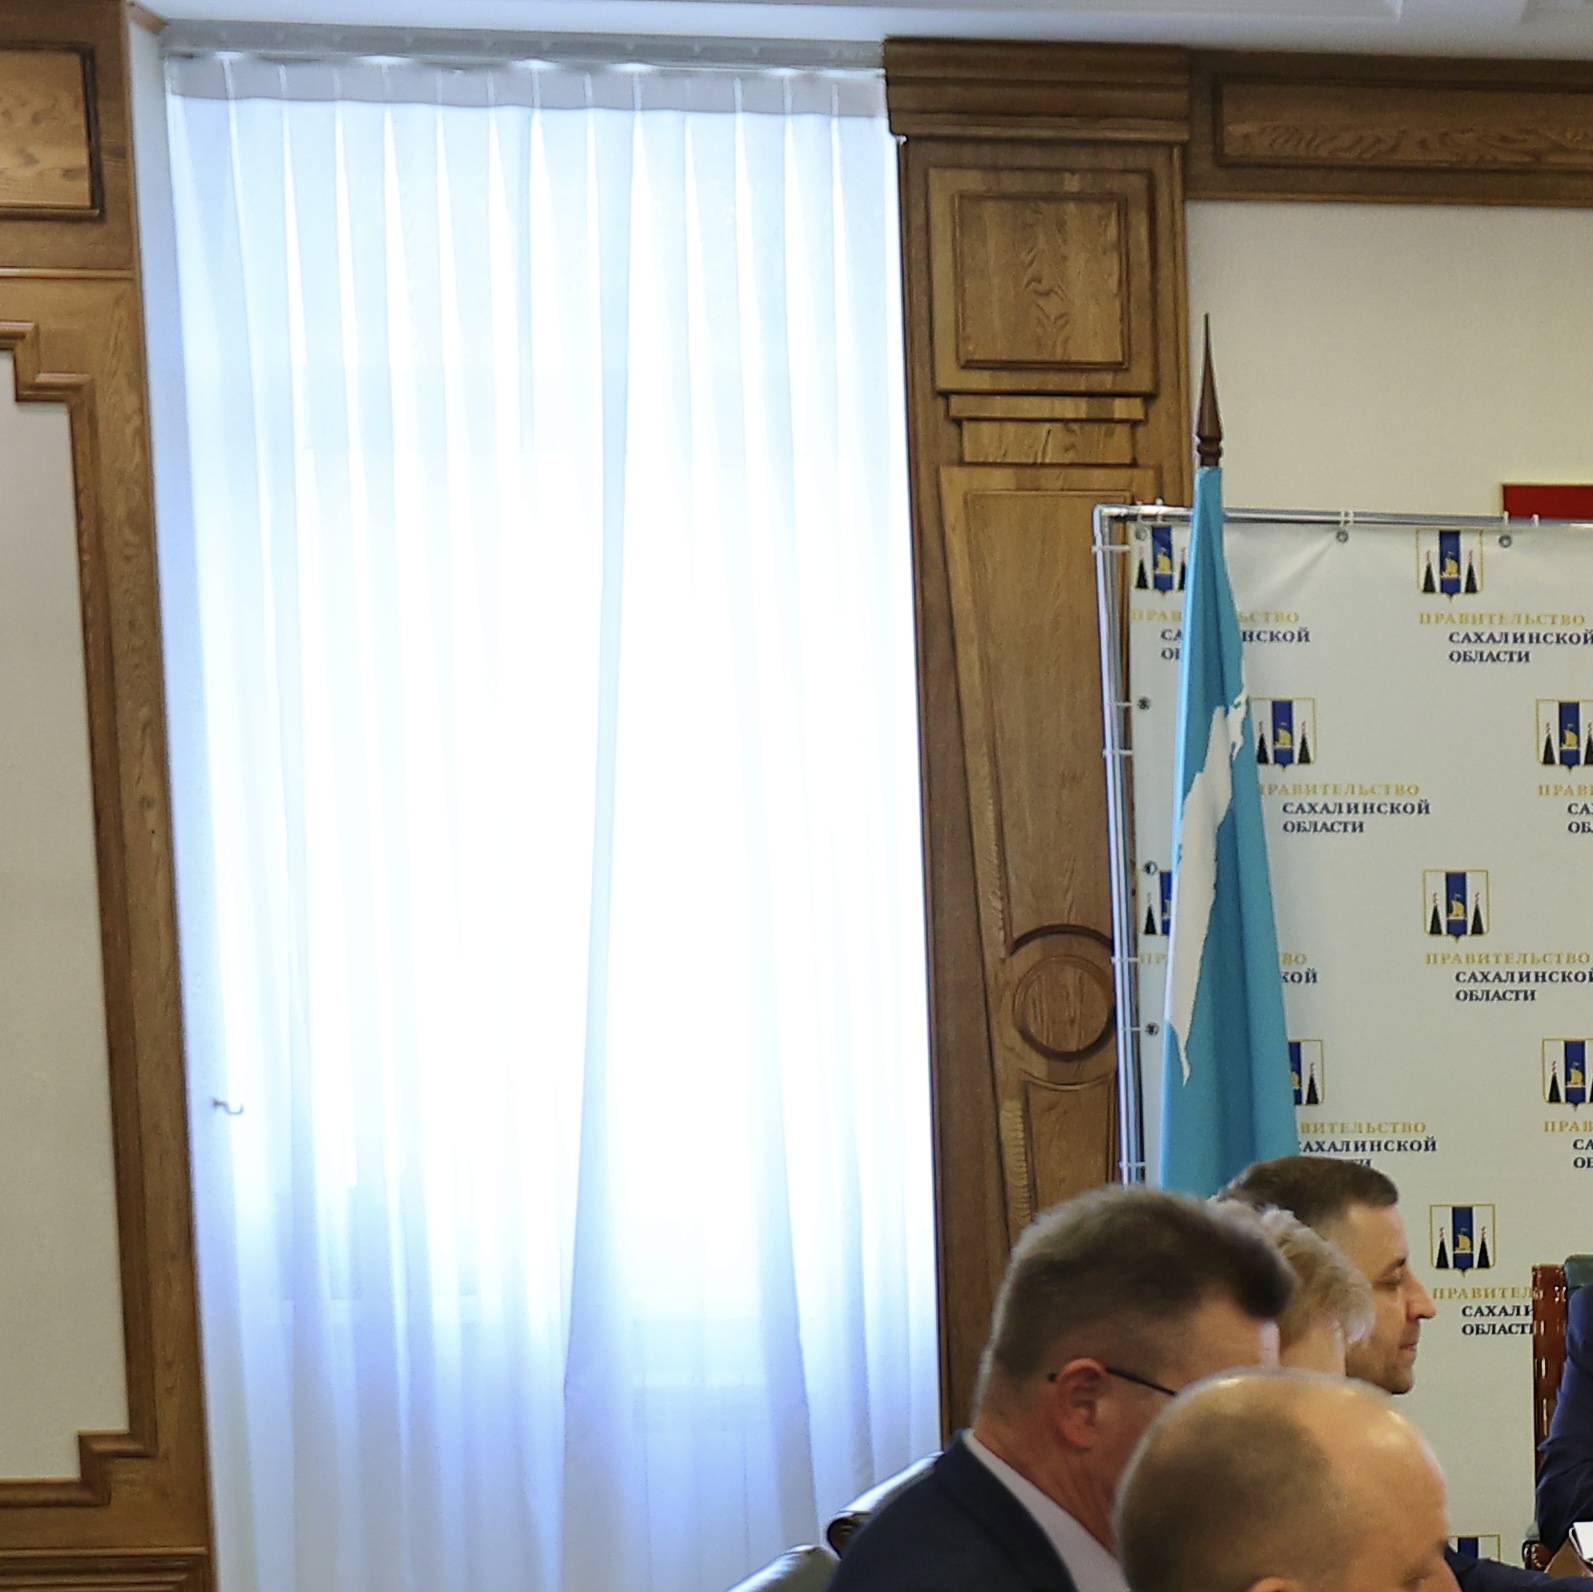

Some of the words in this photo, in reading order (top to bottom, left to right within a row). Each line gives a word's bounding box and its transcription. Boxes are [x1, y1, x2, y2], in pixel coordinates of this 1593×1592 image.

[1160, 627, 1311, 643] САНСКОЙ
[1448, 650, 1530, 663] ОБЛАСТИ
[1282, 799, 1431, 815] САХАЛИНСКОЙ
[1282, 820, 1364, 834] ОБЛАСТИ
[1455, 989, 1537, 1002] ОБЛАСТИ
[1299, 1136, 1437, 1152] АХАЛИНСКОЙ
